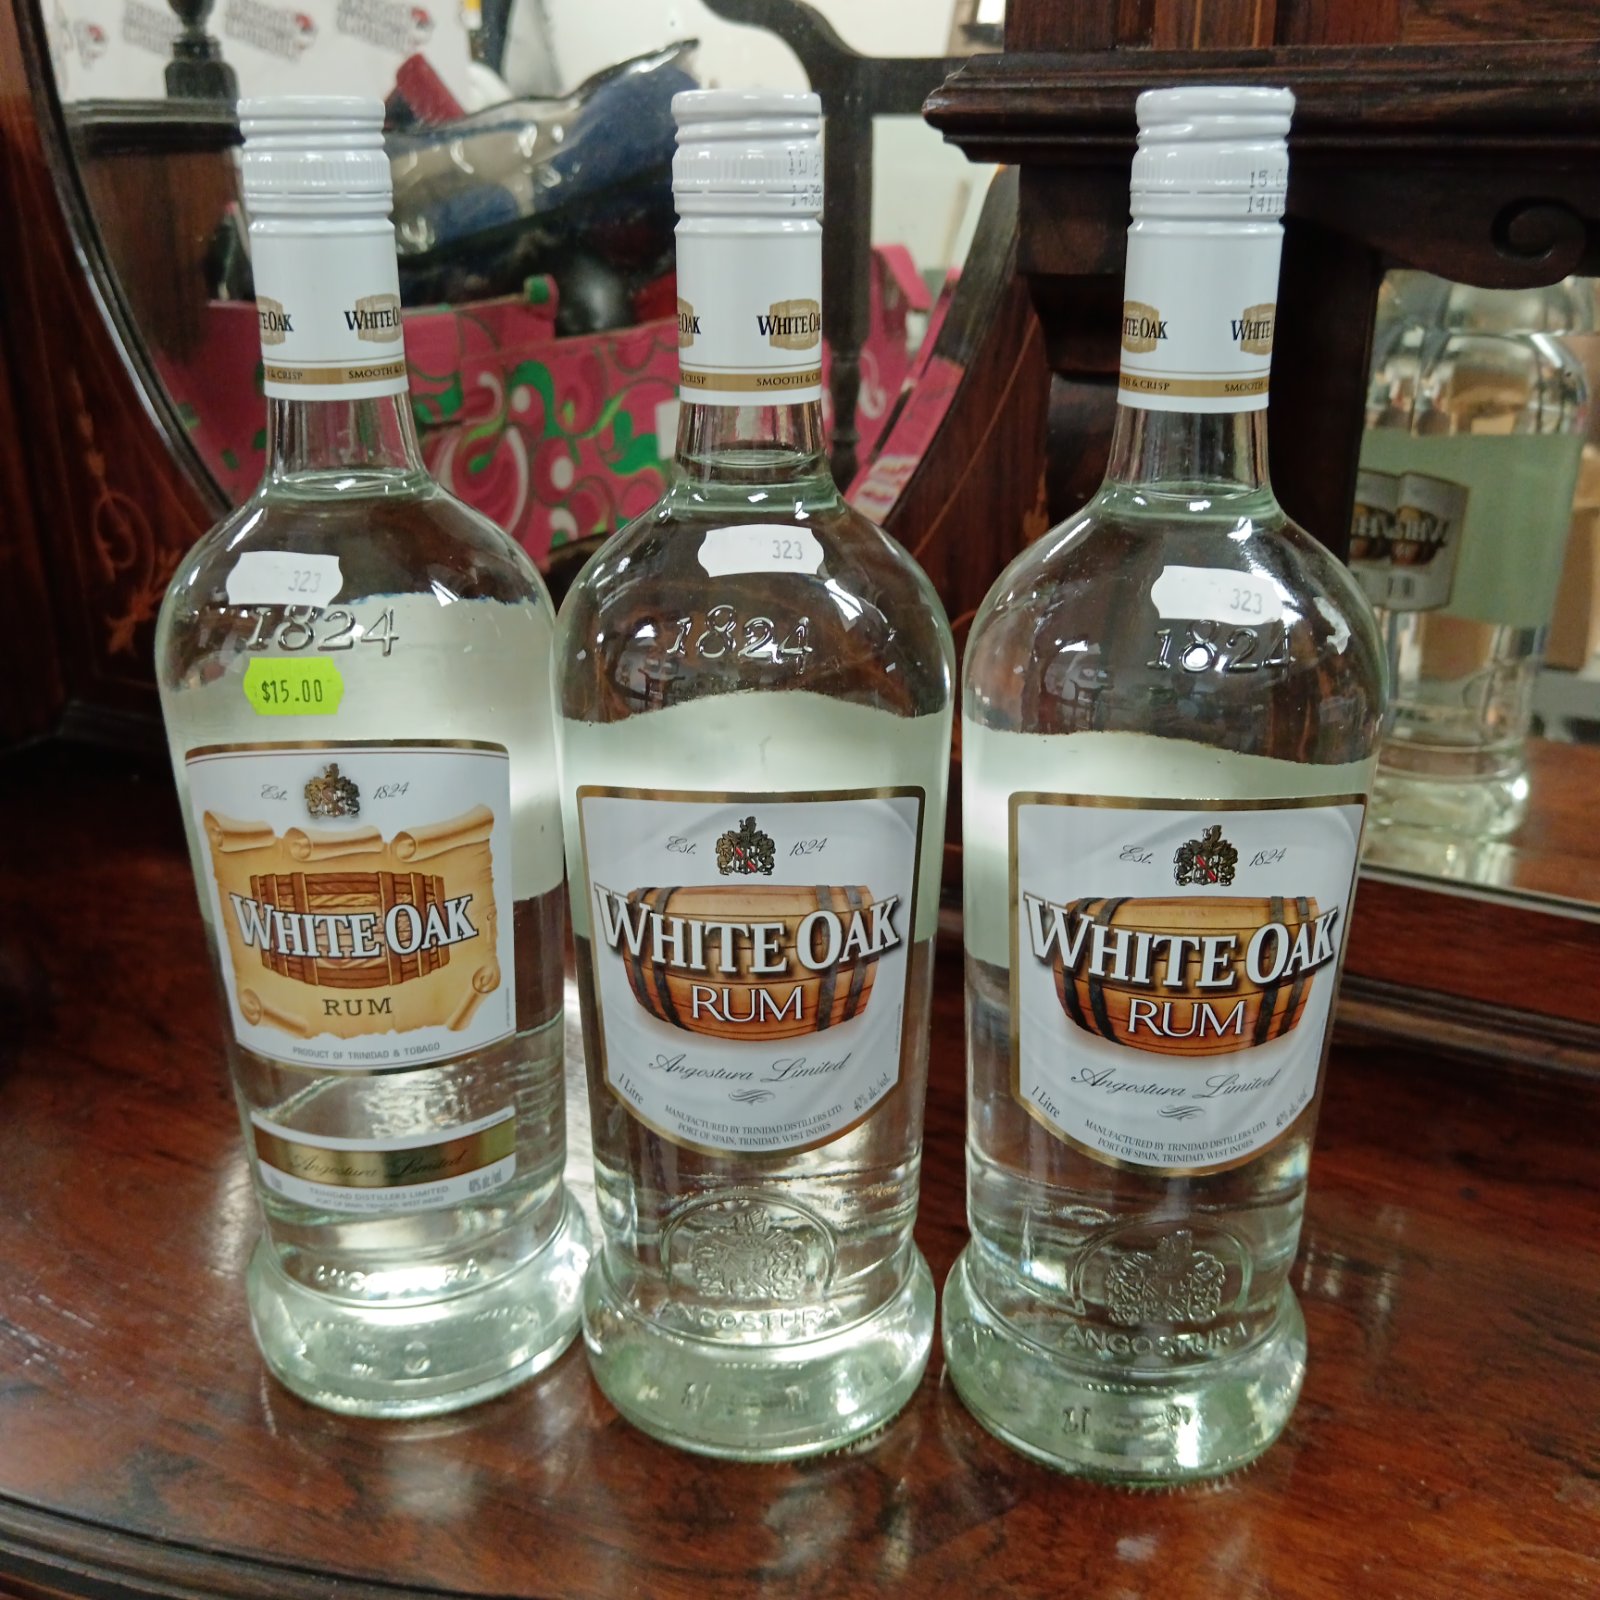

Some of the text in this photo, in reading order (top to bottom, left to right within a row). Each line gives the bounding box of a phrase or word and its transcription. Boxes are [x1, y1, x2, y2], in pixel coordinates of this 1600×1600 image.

[269, 311, 294, 332] OAK
[344, 310, 392, 331] WHITE
[681, 313, 701, 335] OAK
[757, 315, 808, 336] WHITE
[1140, 317, 1168, 339] OAK
[1231, 319, 1271, 341] WHITE
[348, 366, 393, 379] SMOOTH
[756, 376, 803, 387] SMOOTH
[1140, 380, 1170, 391] CRISP
[1224, 381, 1264, 393] SMOOTH
[771, 540, 803, 560] 323
[287, 570, 322, 594] 323
[1229, 588, 1264, 615] 323
[246, 605, 399, 657] 1824
[666, 604, 813, 675] 1824
[261, 679, 323, 704] $15.00
[373, 781, 409, 801] 1824
[789, 838, 828, 857] 1824
[1249, 847, 1287, 867] 1824
[229, 892, 479, 960] WHITE OAK
[594, 882, 902, 974] WHITE OAK
[1023, 892, 1339, 990] WHITE OAK
[323, 997, 393, 1017] RUM
[691, 985, 803, 1023] RUM
[1127, 997, 1247, 1037] RUM
[293, 1046, 329, 1059] PRODUCT
[333, 1051, 343, 1060] OF
[347, 1050, 389, 1060] TRINIDAD
[404, 1041, 440, 1056] TOBAGO
[649, 1052, 851, 1083] Angostura Limited
[1071, 1068, 1281, 1099] Angostura Limited
[1038, 1091, 1060, 1118] Litre
[665, 1104, 728, 1133] MANUFACTURED
[730, 1126, 740, 1134] BY
[742, 1125, 782, 1135] TRINIDAD
[784, 1111, 826, 1132] DISTILLERS
[678, 1122, 698, 1136] PORT
[1085, 1119, 1152, 1149] MANUFACTURED
[1154, 1142, 1165, 1150] BY
[1167, 1140, 1208, 1151] TRINIDAD
[1209, 1130, 1252, 1149] DISTILLERS
[1098, 1138, 1119, 1152] PORT
[1121, 1146, 1131, 1156] OF
[1134, 1148, 1160, 1162] SPAIN,
[1207, 1148, 1227, 1160] WEST
[1229, 1139, 1254, 1155] INDIES
